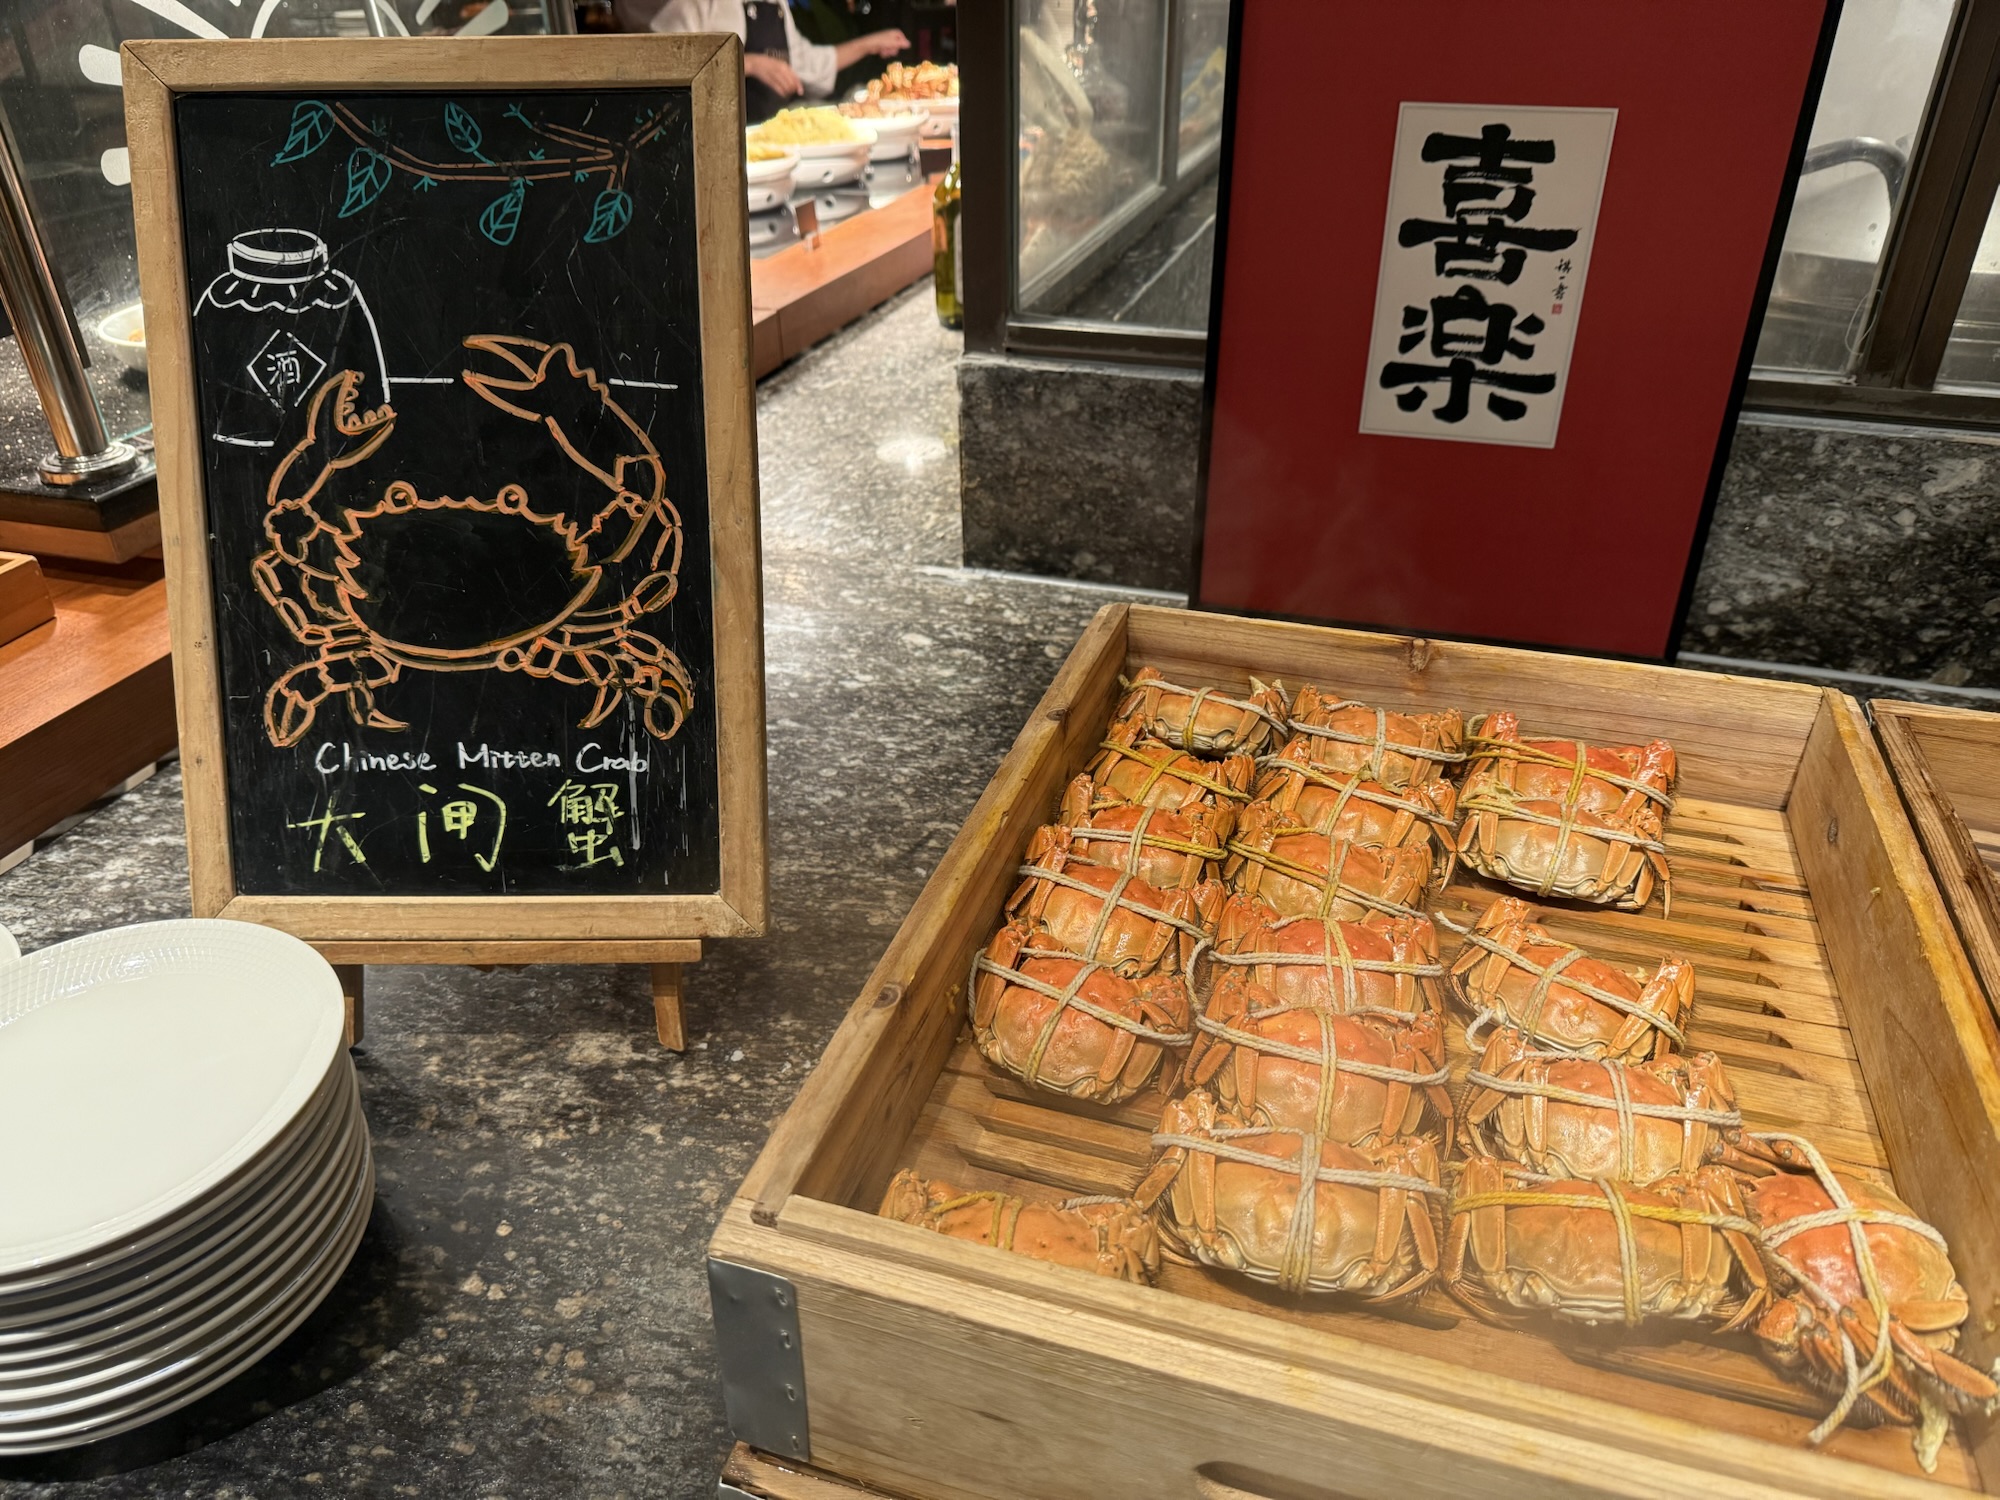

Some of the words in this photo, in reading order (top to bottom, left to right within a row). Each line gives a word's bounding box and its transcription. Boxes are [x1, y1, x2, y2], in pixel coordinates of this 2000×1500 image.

[266, 350, 300, 396] 酒
[315, 742, 437, 774] Chinese
[457, 742, 561, 769] Mitten
[575, 743, 649, 774] Crab
